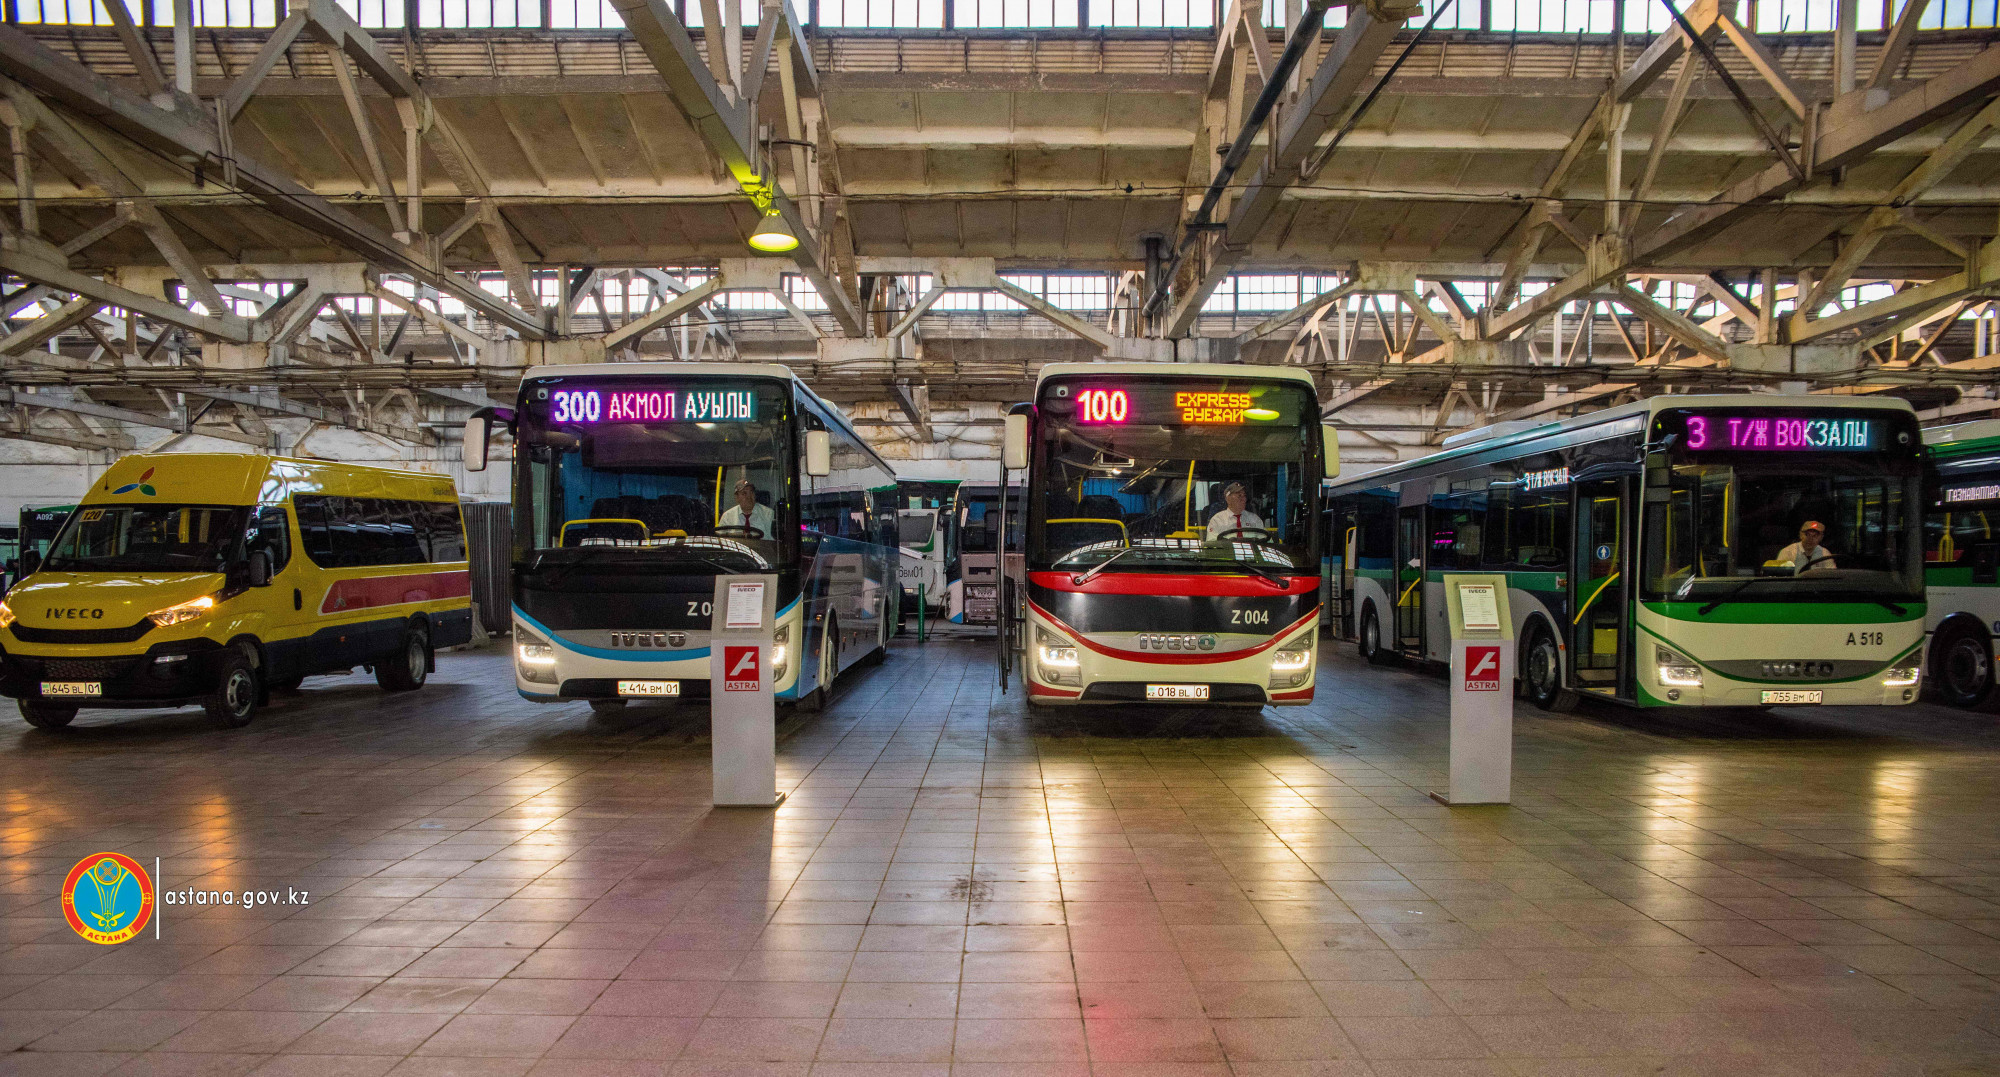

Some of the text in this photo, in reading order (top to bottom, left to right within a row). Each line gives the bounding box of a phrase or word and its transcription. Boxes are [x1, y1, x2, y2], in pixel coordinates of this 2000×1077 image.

[554, 391, 600, 422] 300
[684, 393, 751, 418] АУЫЛЫ
[1078, 390, 1127, 421] 100
[1176, 393, 1250, 407] EXPRESS
[1687, 417, 1868, 447] 3 Т/Ж ВОКЗАЛЫ
[84, 510, 102, 520] 120
[45, 608, 104, 619] IVECO
[687, 601, 698, 616] Z
[701, 602, 713, 616] 0
[1231, 610, 1269, 624] Z 004
[611, 631, 687, 648] IVECO
[1140, 633, 1216, 651] IVECO
[1846, 632, 1883, 646] A 518
[1761, 661, 1834, 677] IVECO
[52, 684, 70, 693] 645
[72, 686, 83, 694] BL
[88, 684, 100, 693] 01
[629, 684, 647, 693] 414
[666, 684, 678, 693] 01
[1157, 687, 1176, 697] 018
[1195, 687, 1208, 697] 01
[1467, 681, 1497, 689] ASTRA
[1774, 692, 1791, 702] 755
[1809, 692, 1820, 702] 01
